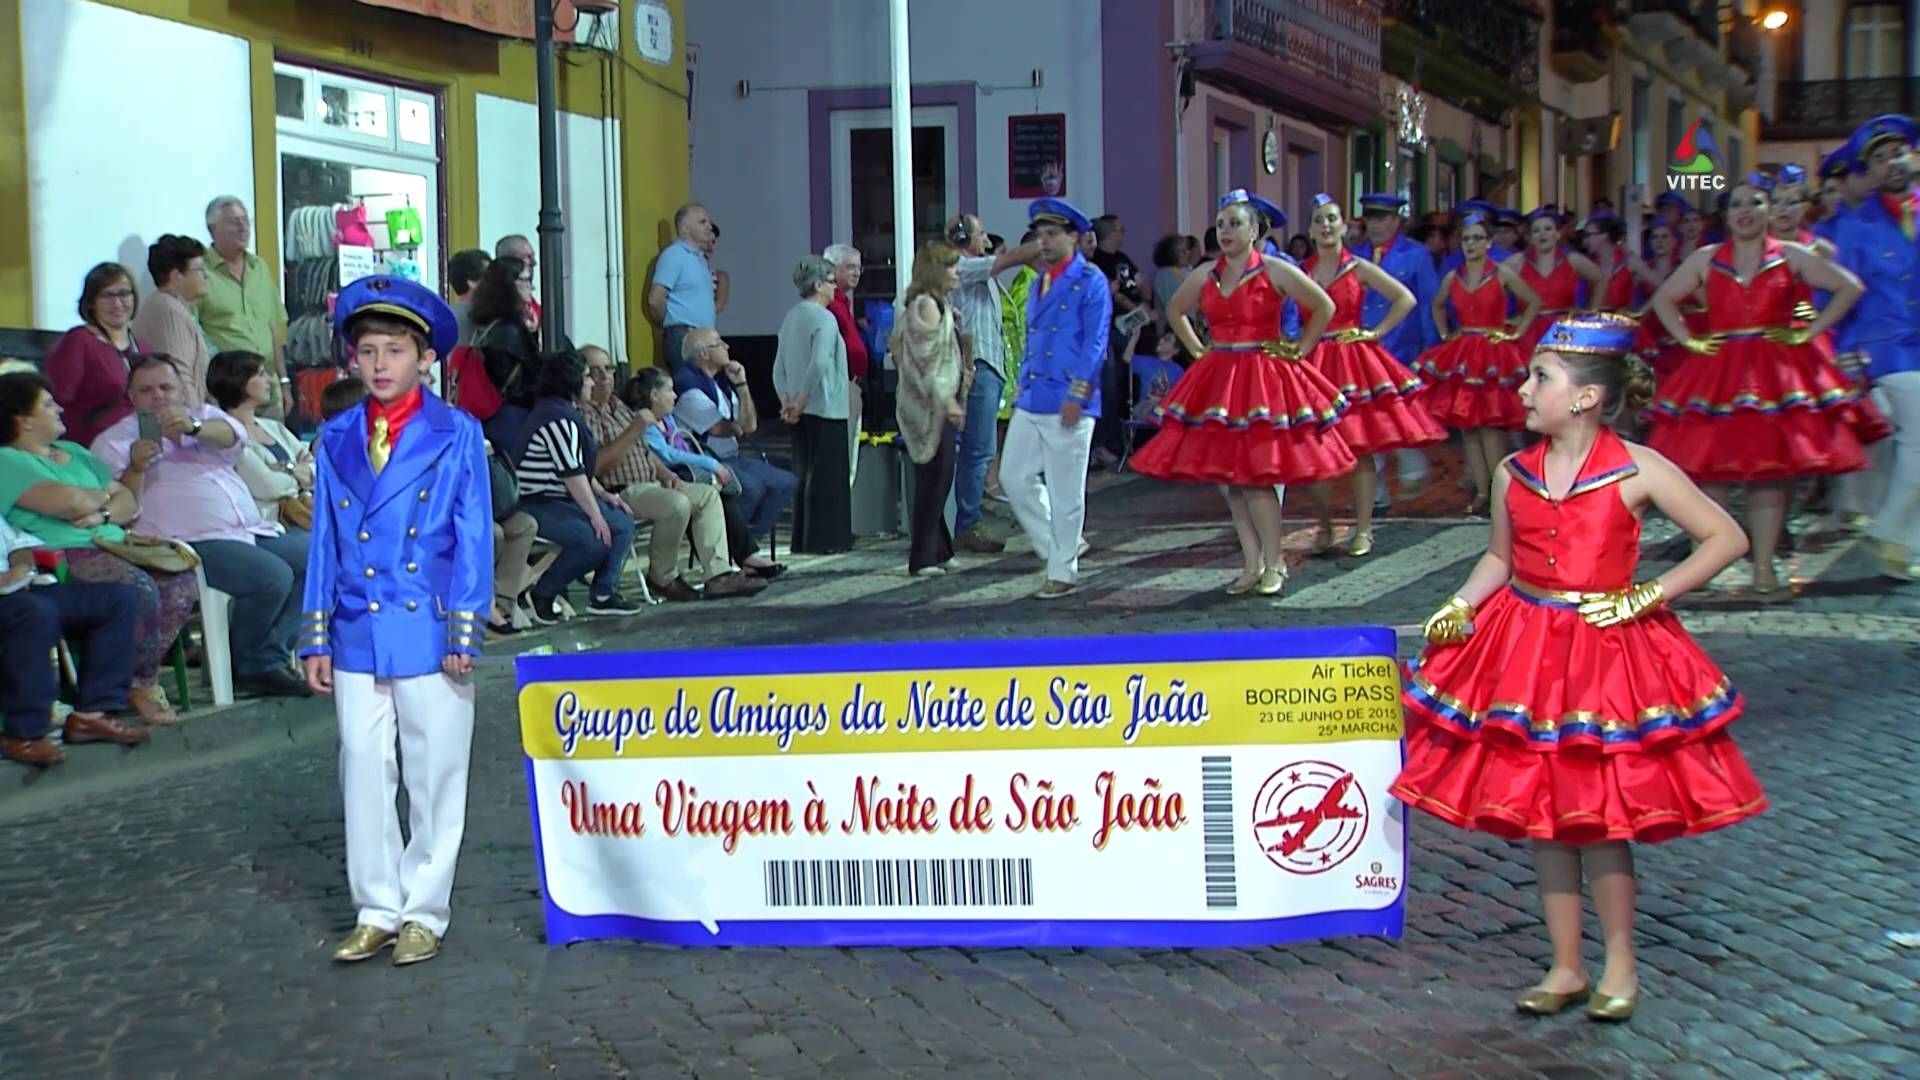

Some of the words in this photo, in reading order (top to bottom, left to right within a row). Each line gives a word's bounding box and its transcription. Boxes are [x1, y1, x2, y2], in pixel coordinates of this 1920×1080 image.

[1312, 664, 1335, 680] Air
[1341, 663, 1392, 679] Ticket
[1245, 687, 1337, 705] BORDING
[1344, 685, 1395, 702] PASS
[555, 690, 655, 756] Grupo
[665, 688, 702, 738] de
[710, 686, 829, 752] Amigos
[841, 682, 887, 737] da
[897, 679, 986, 734] Noite
[995, 677, 1036, 731] de
[1045, 675, 1113, 730] São
[1122, 672, 1209, 744] João
[1259, 711, 1274, 723] 23
[1277, 711, 1294, 722] DE
[1298, 709, 1343, 722] JUNHO
[1346, 708, 1364, 720] DE
[1368, 707, 1397, 720] 2015
[1341, 722, 1398, 735] MARCHA
[561, 779, 645, 837] Uma
[655, 778, 794, 856] Viagem
[803, 779, 829, 837] à
[841, 774, 938, 835] Noite
[950, 773, 994, 834] de
[1005, 771, 1080, 833] São
[1092, 770, 1189, 851] João
[1355, 874, 1397, 890] SAGRES
